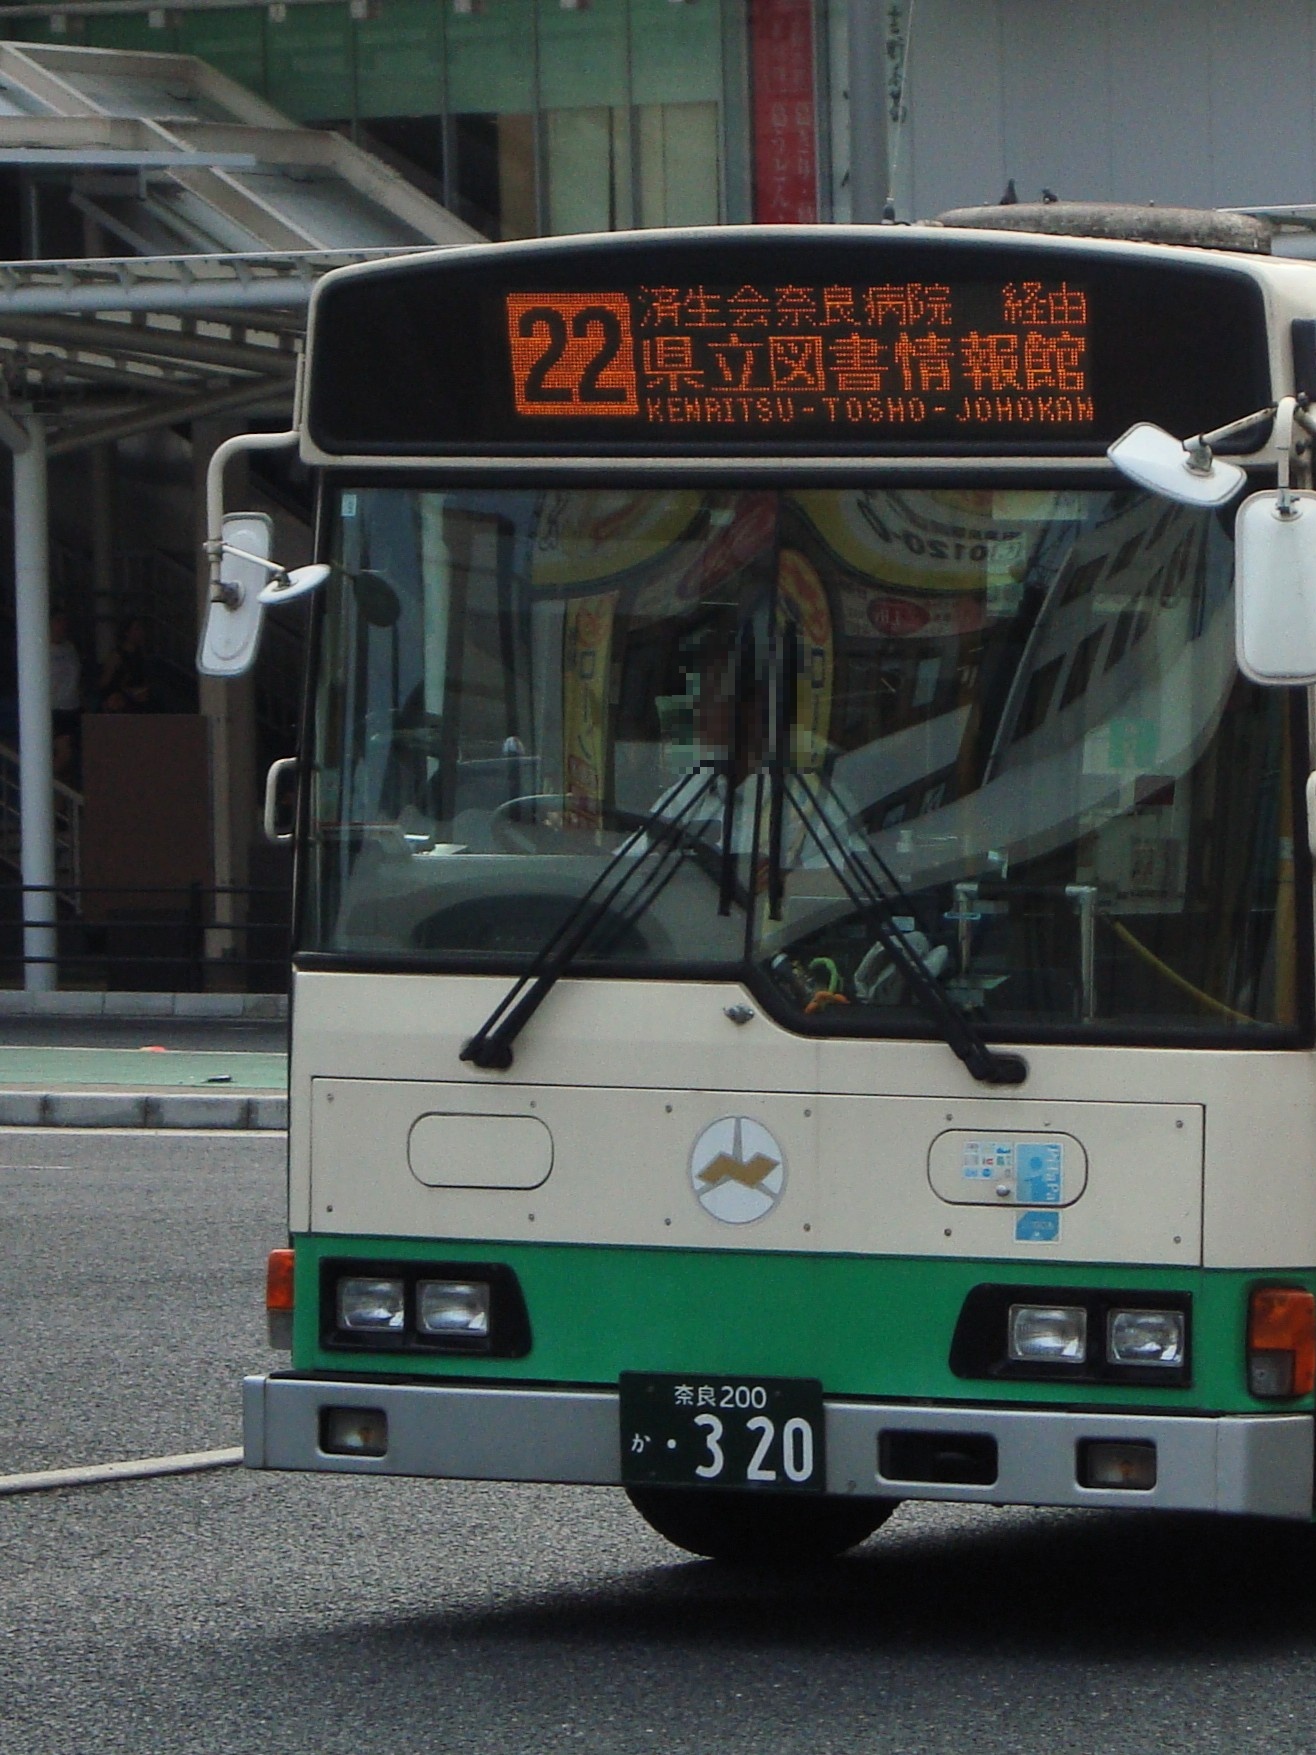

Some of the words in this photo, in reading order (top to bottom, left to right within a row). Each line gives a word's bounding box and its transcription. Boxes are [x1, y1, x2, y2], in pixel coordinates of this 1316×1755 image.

[637, 283, 953, 327] 済生会奈良病院
[1001, 281, 1088, 325] 経由
[516, 305, 630, 403] 22
[641, 330, 1088, 393] 県立図書情報館
[646, 396, 1095, 423] KENRITSU-TOSHO-JOHOKAN
[631, 1432, 651, 1454] か
